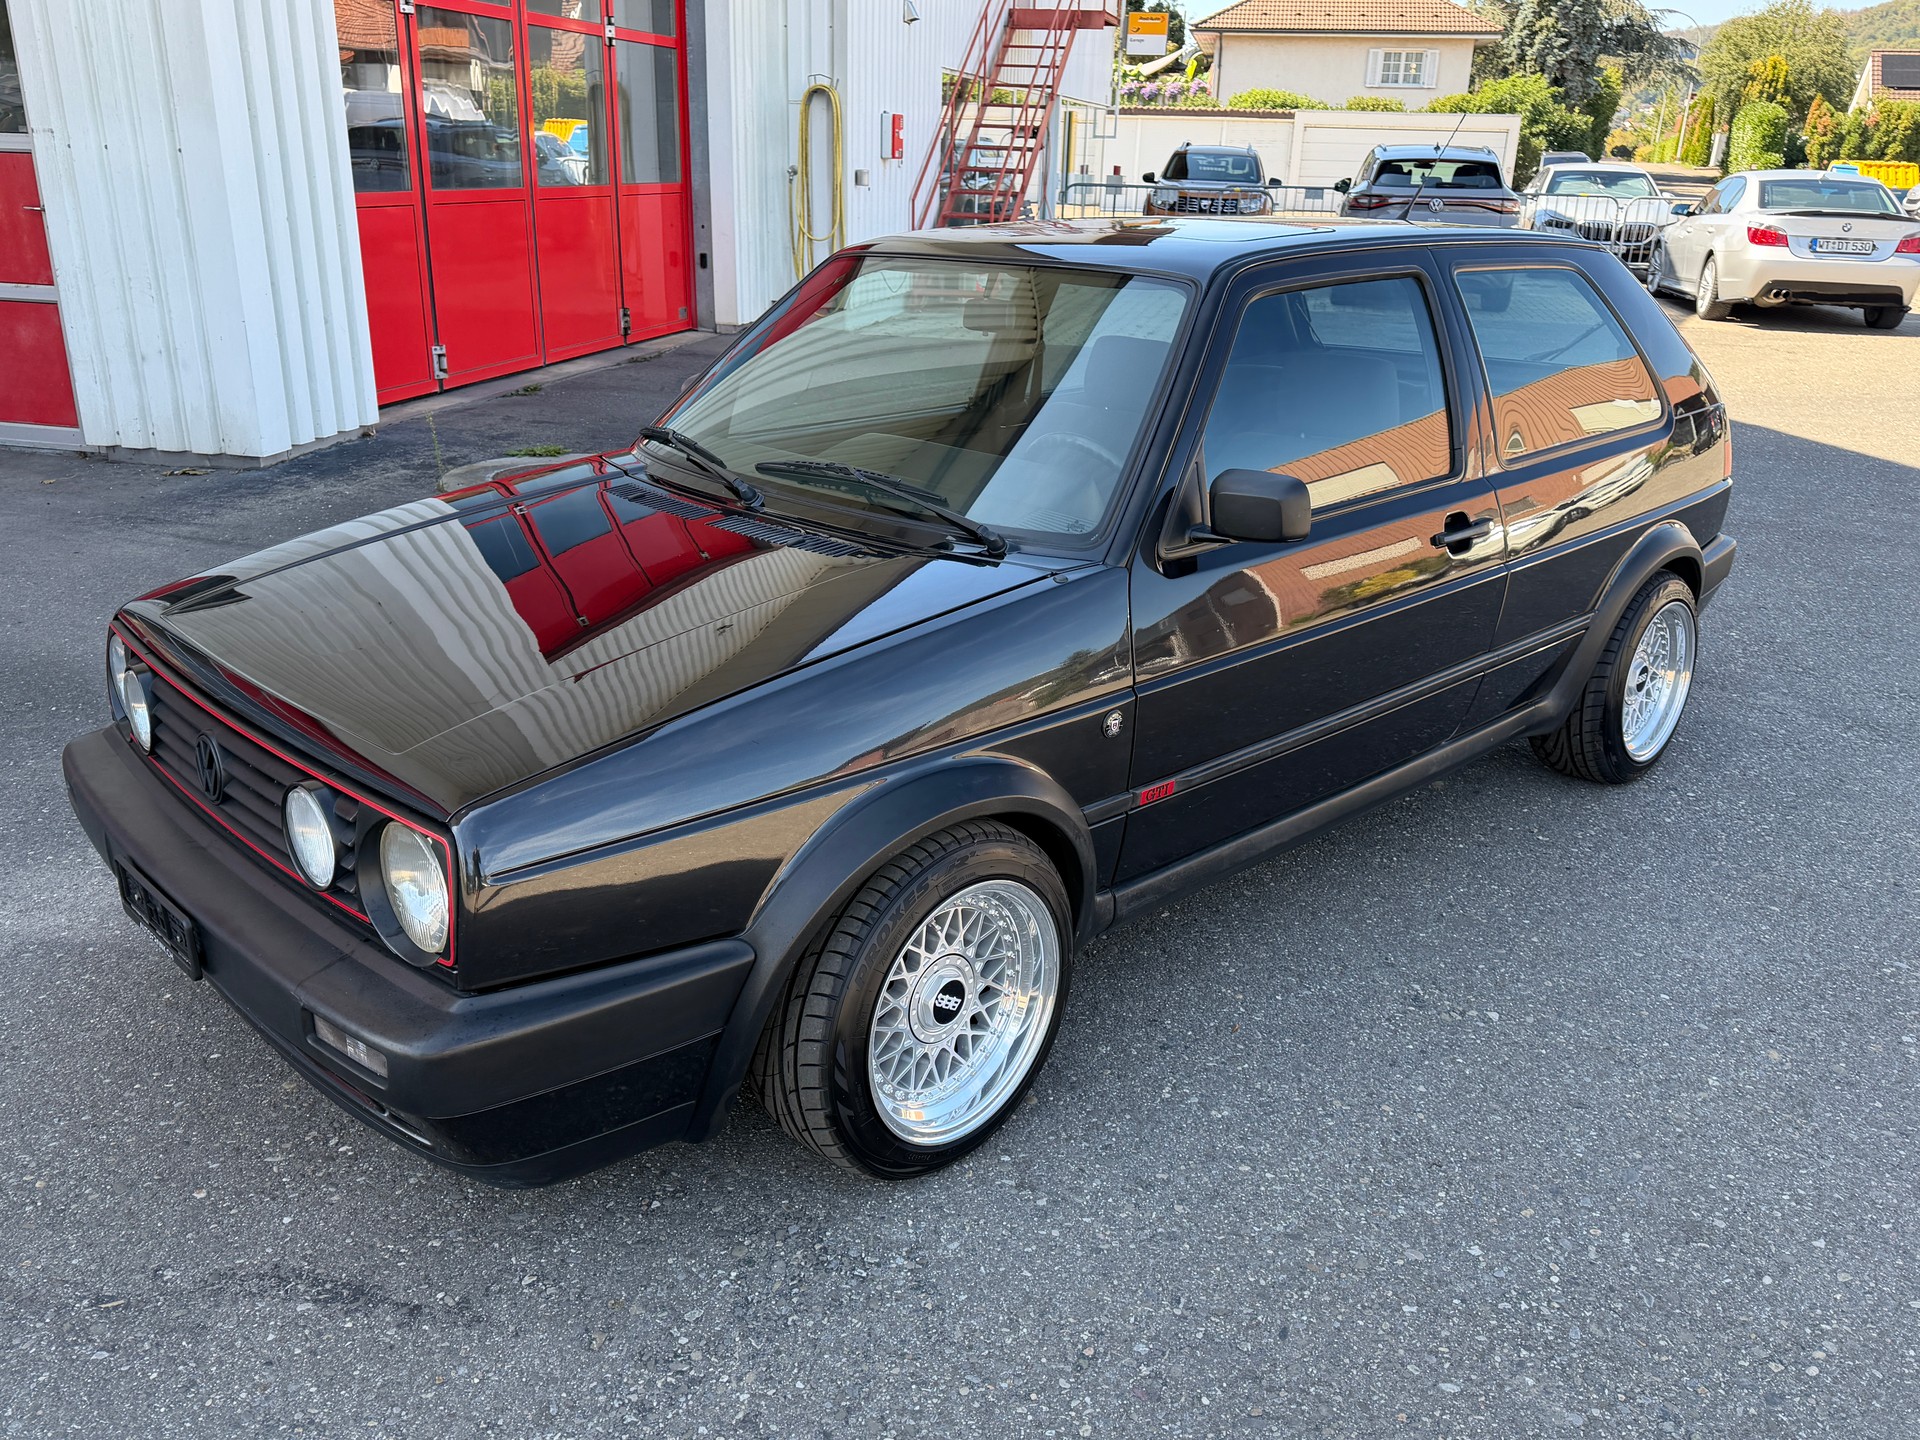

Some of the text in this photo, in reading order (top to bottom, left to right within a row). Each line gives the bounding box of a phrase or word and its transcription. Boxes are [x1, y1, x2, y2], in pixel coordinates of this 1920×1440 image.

[1851, 242, 1871, 252] 530
[1145, 783, 1170, 801] GTI
[854, 873, 932, 989] PROXES
